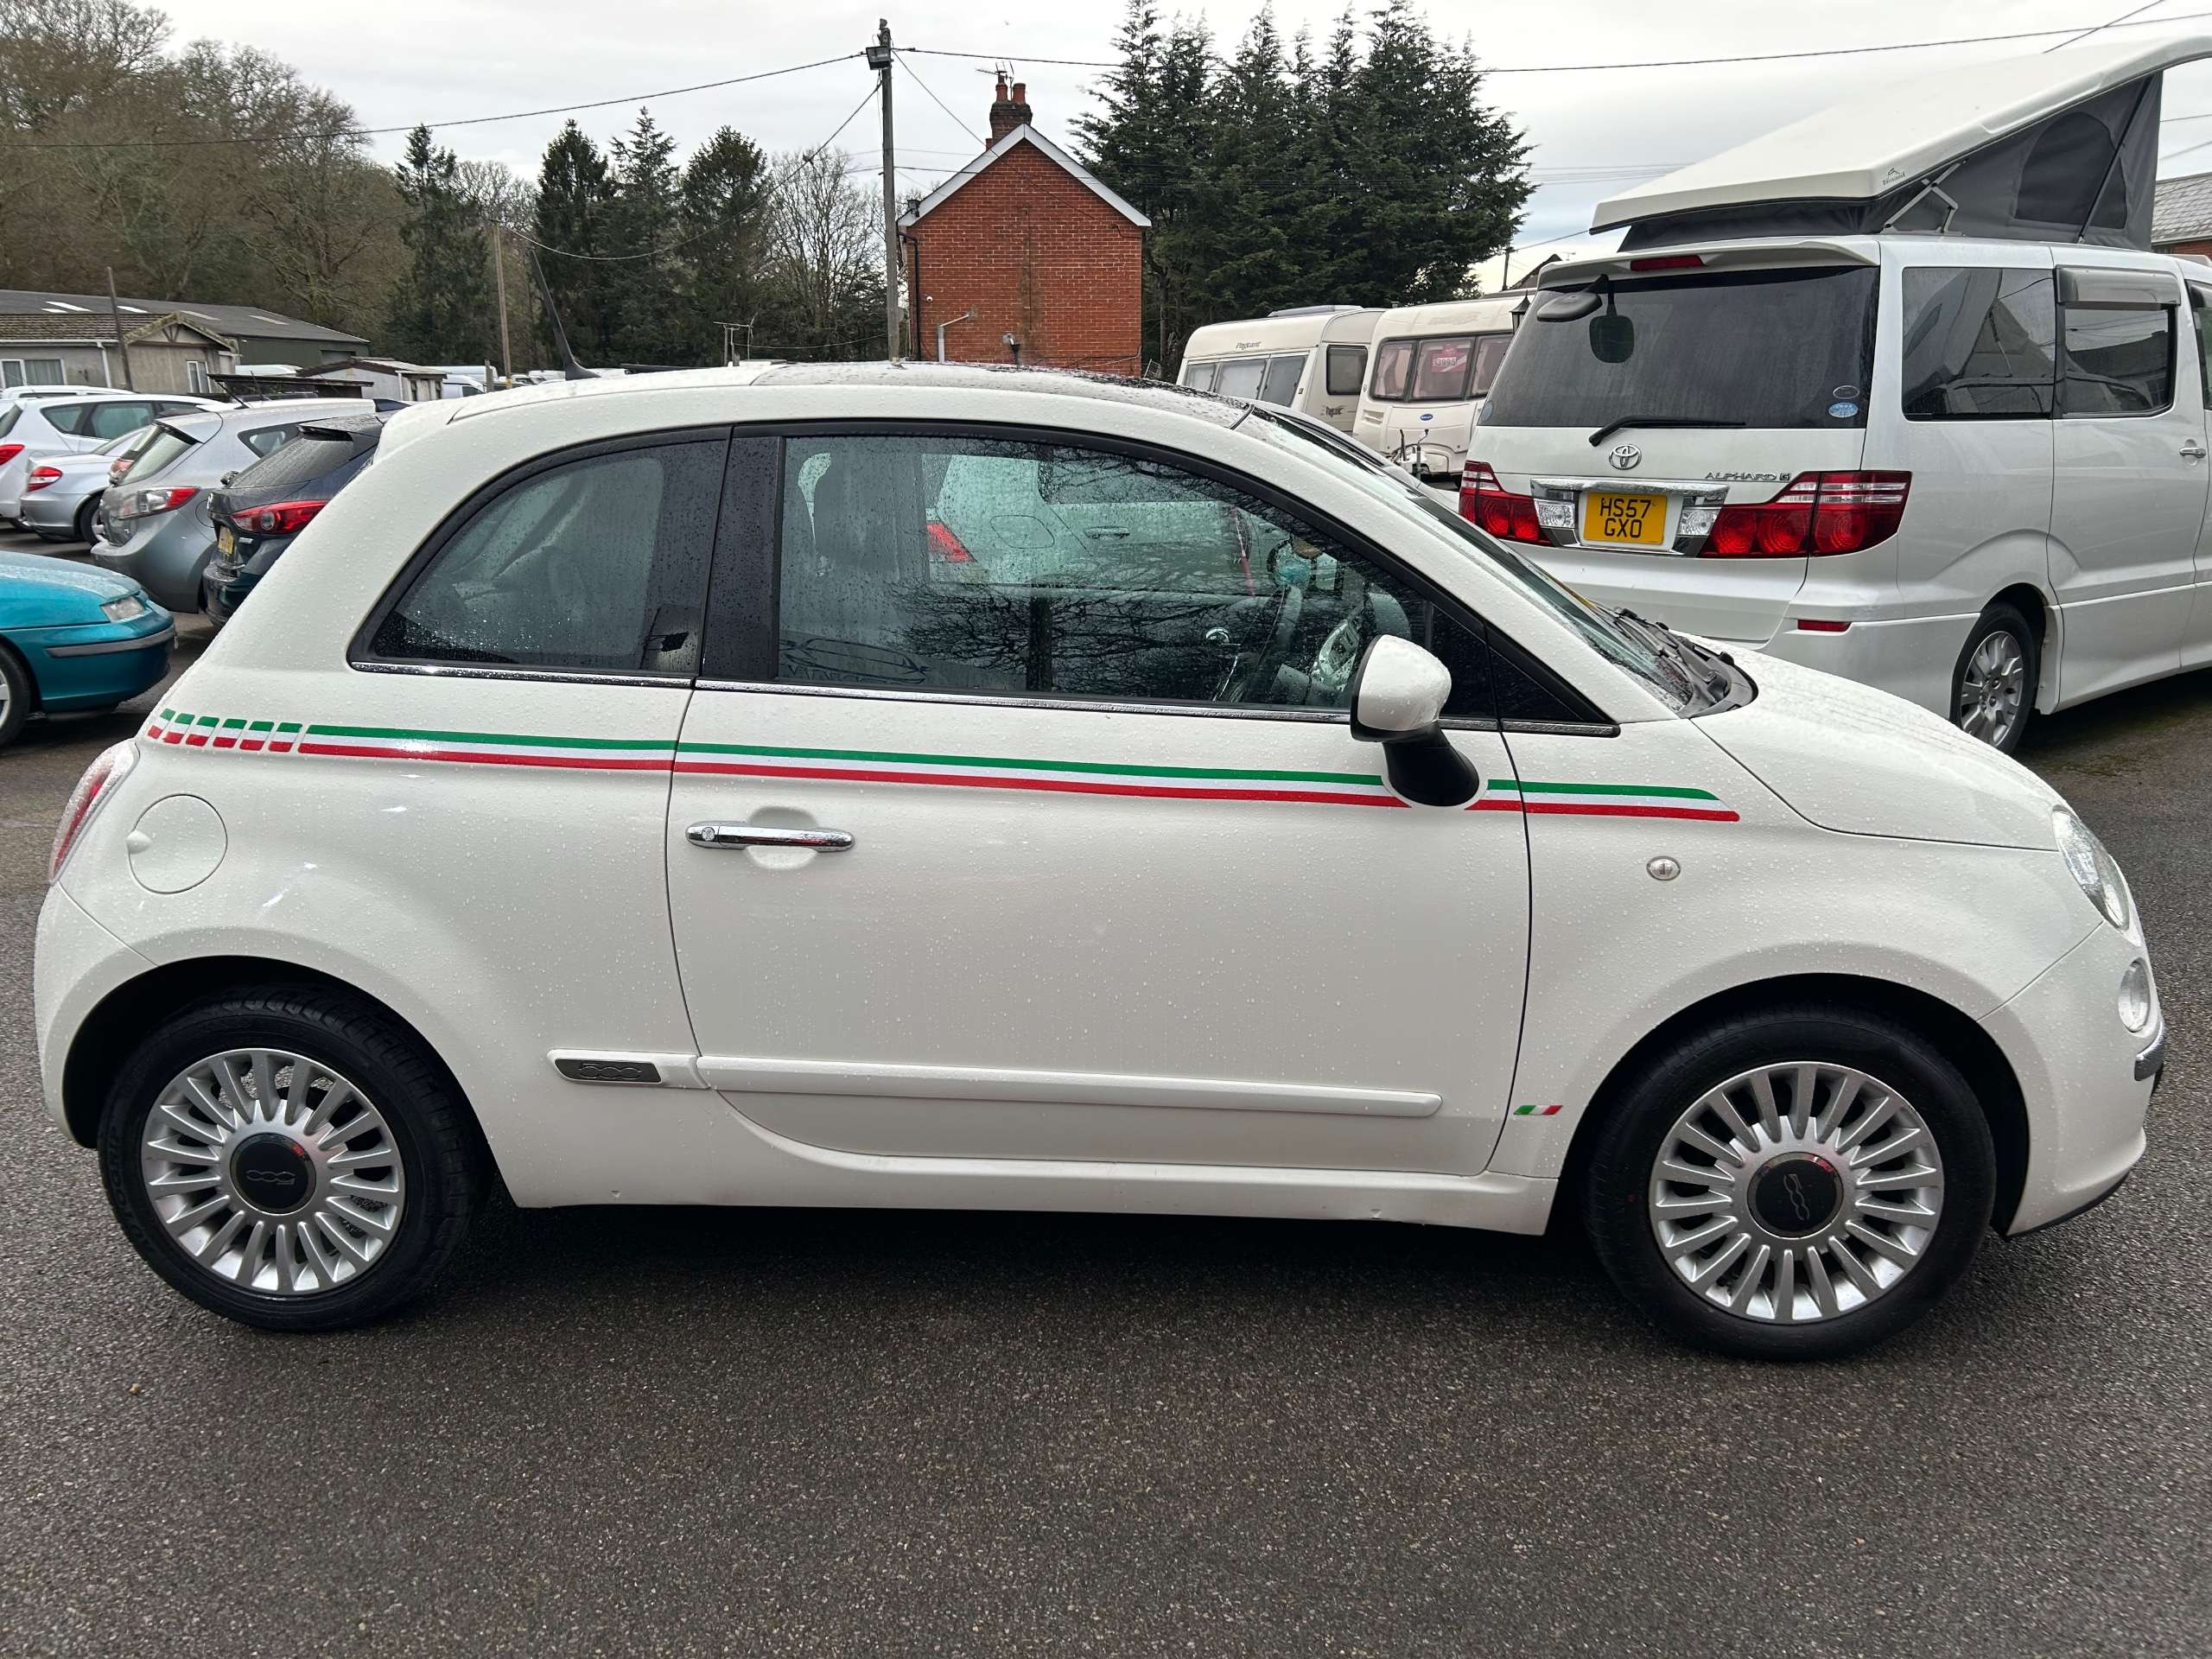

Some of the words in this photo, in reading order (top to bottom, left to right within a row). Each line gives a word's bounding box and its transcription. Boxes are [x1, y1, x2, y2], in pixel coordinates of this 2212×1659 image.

[1705, 472, 1777, 481] ALPHARD
[1599, 497, 1652, 519] HS57
[1604, 518, 1643, 538] GXO
